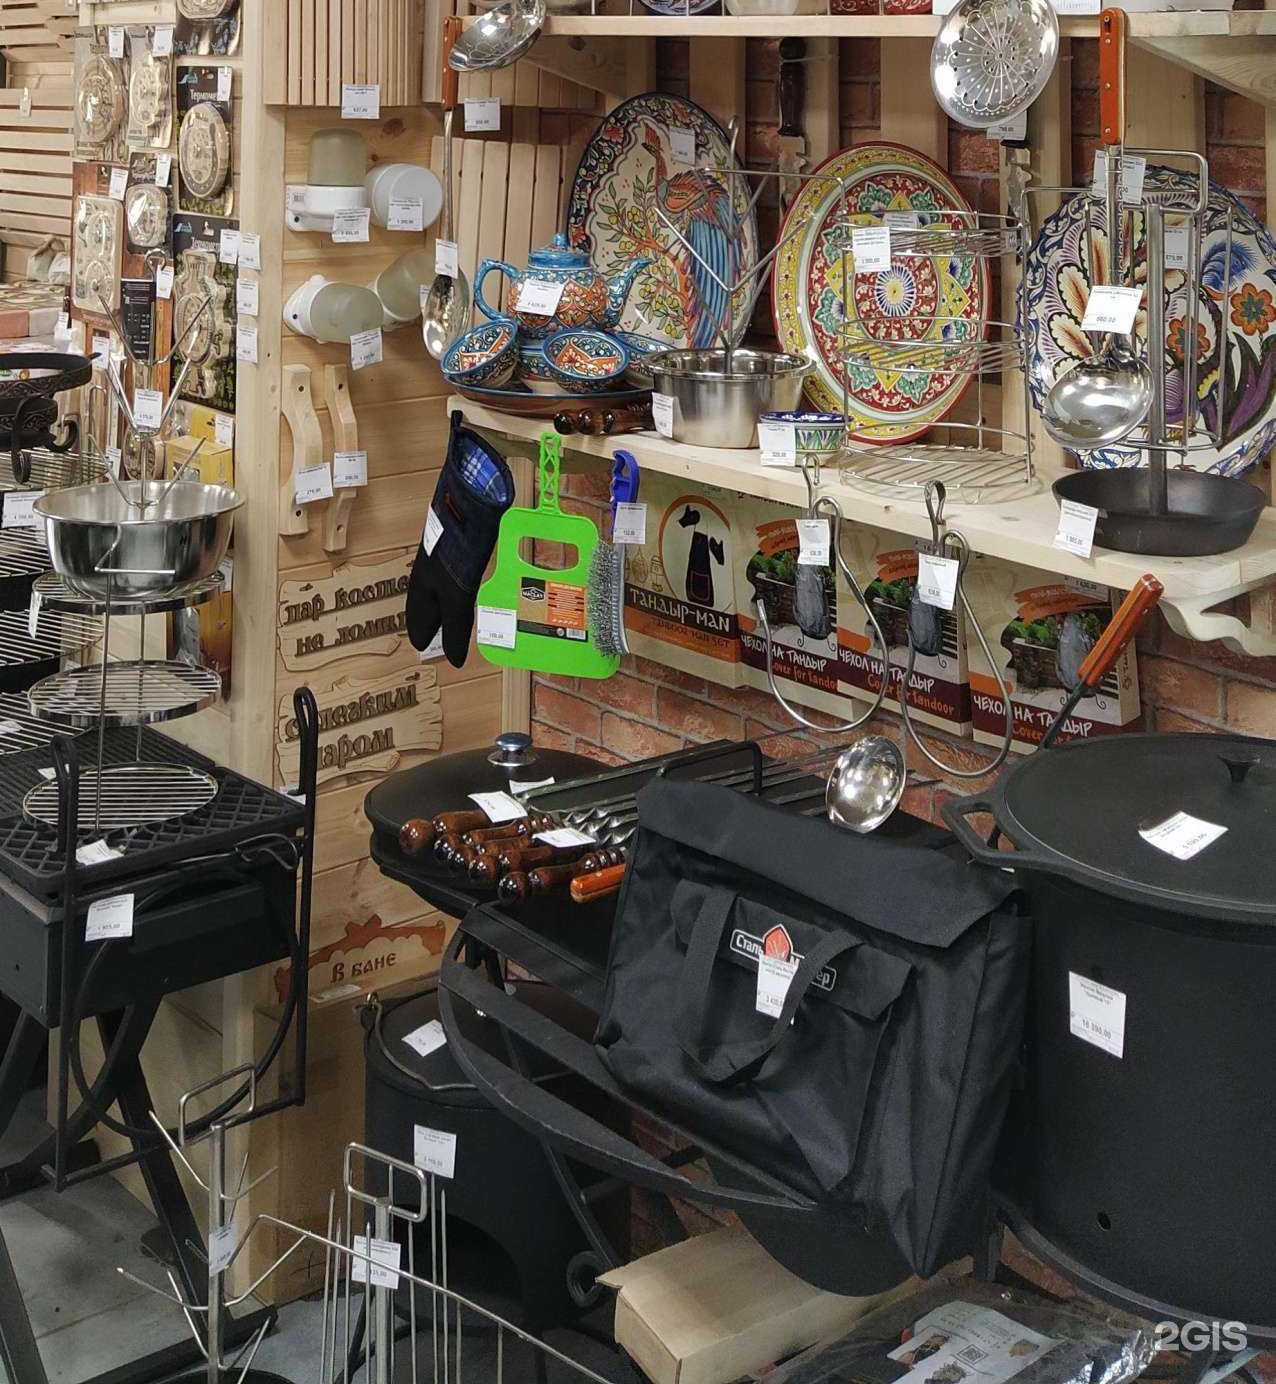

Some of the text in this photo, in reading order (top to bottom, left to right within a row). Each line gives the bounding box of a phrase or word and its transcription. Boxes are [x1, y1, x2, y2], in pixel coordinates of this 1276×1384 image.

[334, 573, 411, 613] косте
[787, 649, 828, 672] ТАНДЫР
[838, 647, 869, 673] ЧЕХОЛ
[808, 672, 838, 691] tando
[867, 674, 897, 696] Coer
[973, 694, 1093, 738] ЧЕХО НА ТАДЫР
